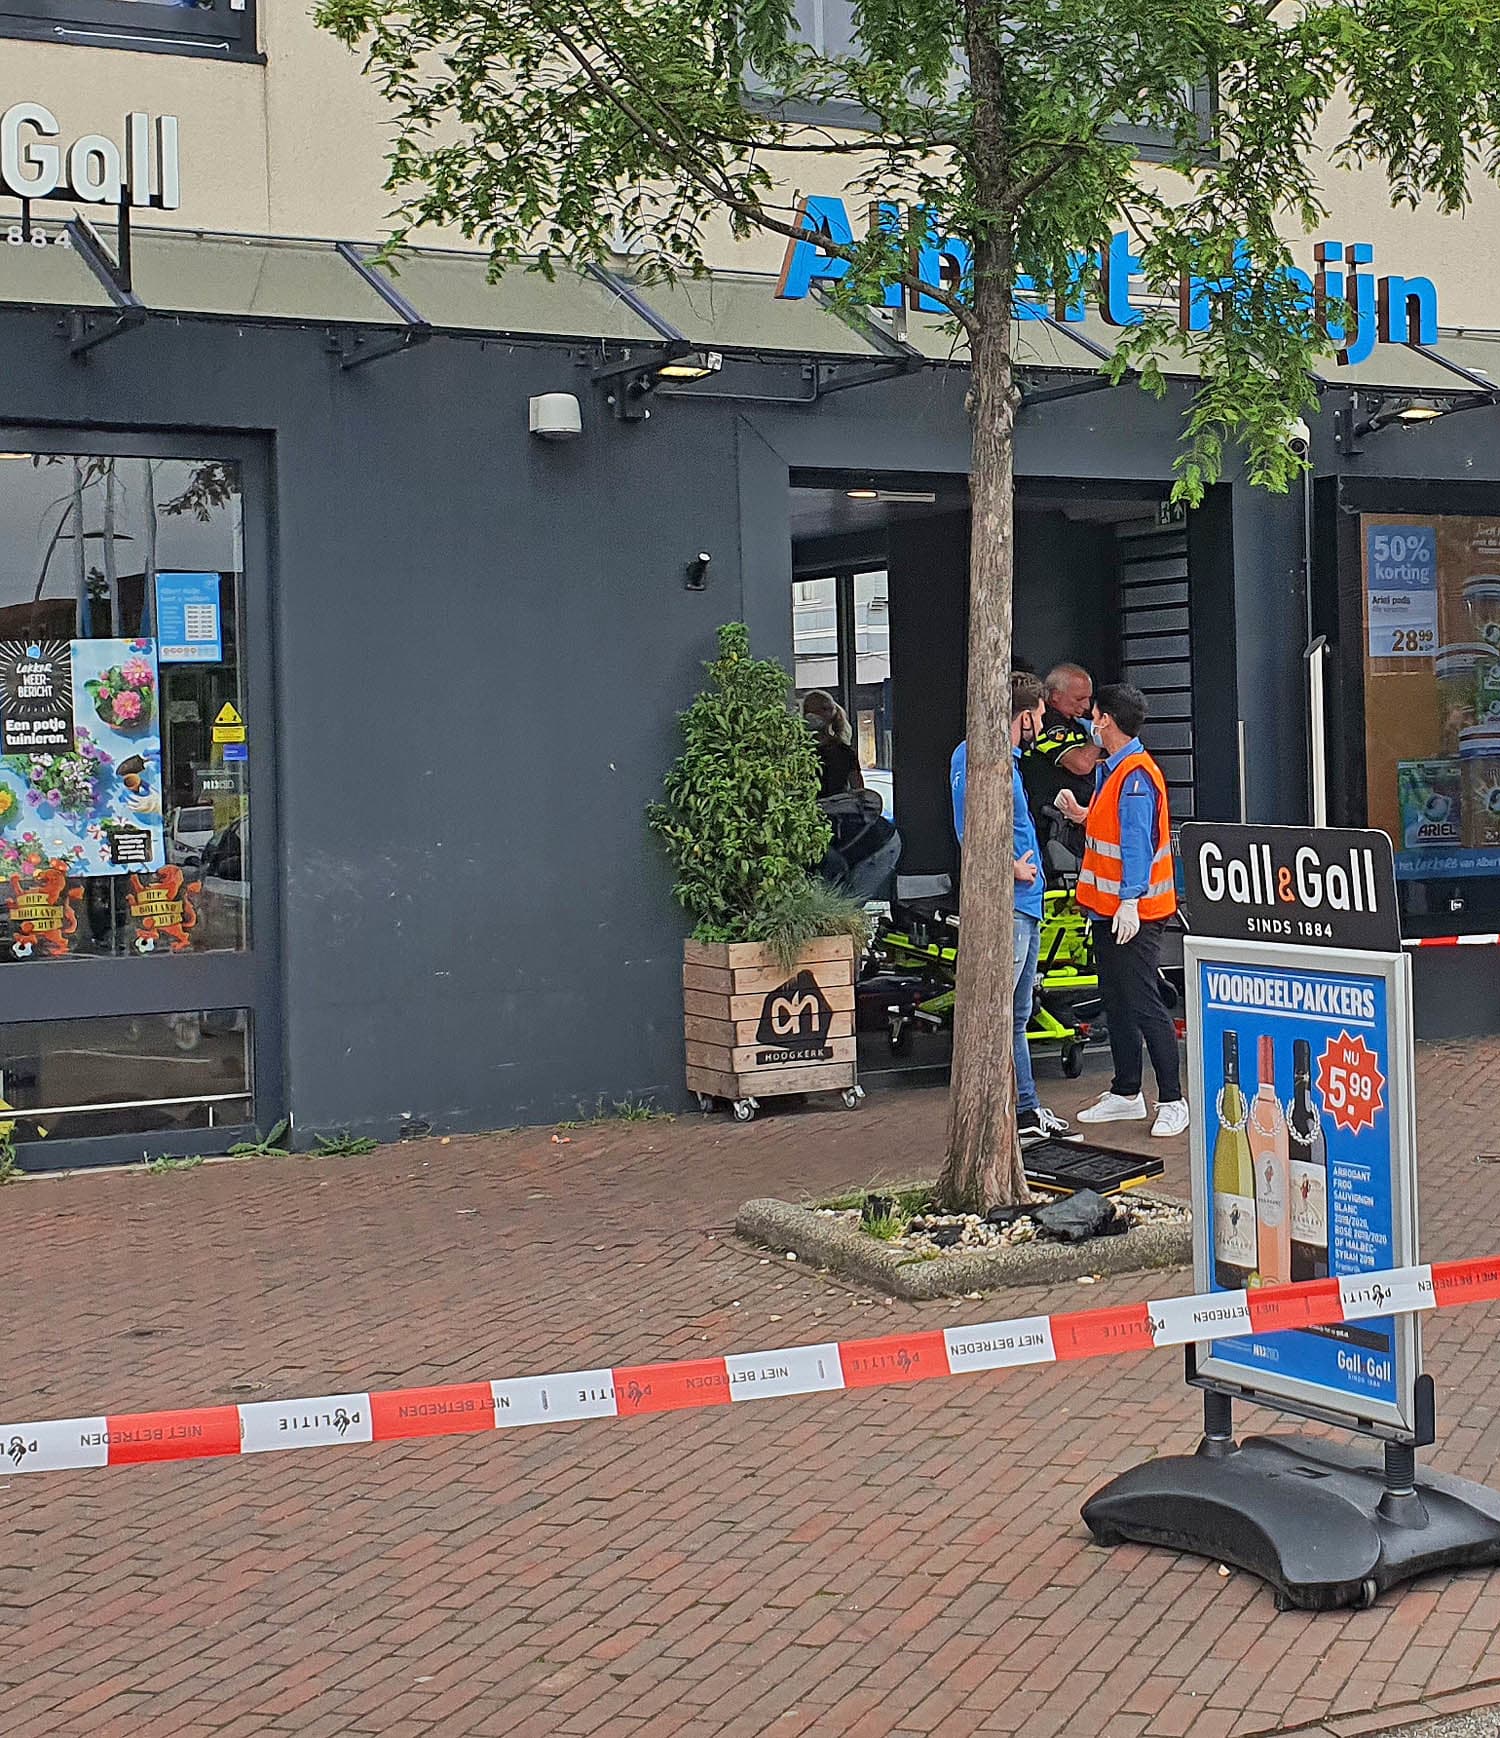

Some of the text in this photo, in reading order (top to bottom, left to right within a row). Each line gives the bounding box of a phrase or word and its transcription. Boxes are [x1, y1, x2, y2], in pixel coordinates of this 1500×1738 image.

[1, 102, 180, 209] Gall
[1374, 535, 1431, 562] 50%
[1375, 562, 1430, 584] korting
[17, 685, 53, 698] BERICHT
[6, 717, 66, 732] Een potje
[1418, 823, 1457, 837] ARIEL
[1247, 917, 1333, 938] SINDS 1884
[1207, 971, 1376, 1019] VOORDEELPAKKERS
[765, 1048, 825, 1063] HOOGKERK
[1343, 1049, 1360, 1066] NU
[1329, 1067, 1372, 1116] 5.99
[1334, 1201, 1358, 1215] BLANC
[1335, 1237, 1345, 1248] OF
[1335, 1248, 1359, 1264] SYRAH
[1103, 1315, 1165, 1337] POLITIE
[950, 1333, 1044, 1356] NIET BETREDEN
[853, 1350, 921, 1371] POLITIE
[686, 1367, 788, 1388] NIET BETREDEN
[578, 1381, 652, 1402] POLITIE
[399, 1396, 511, 1418] NIET BETREDEN
[279, 1408, 361, 1432] POLITIE
[81, 1425, 202, 1447] NIET BETREDEN
